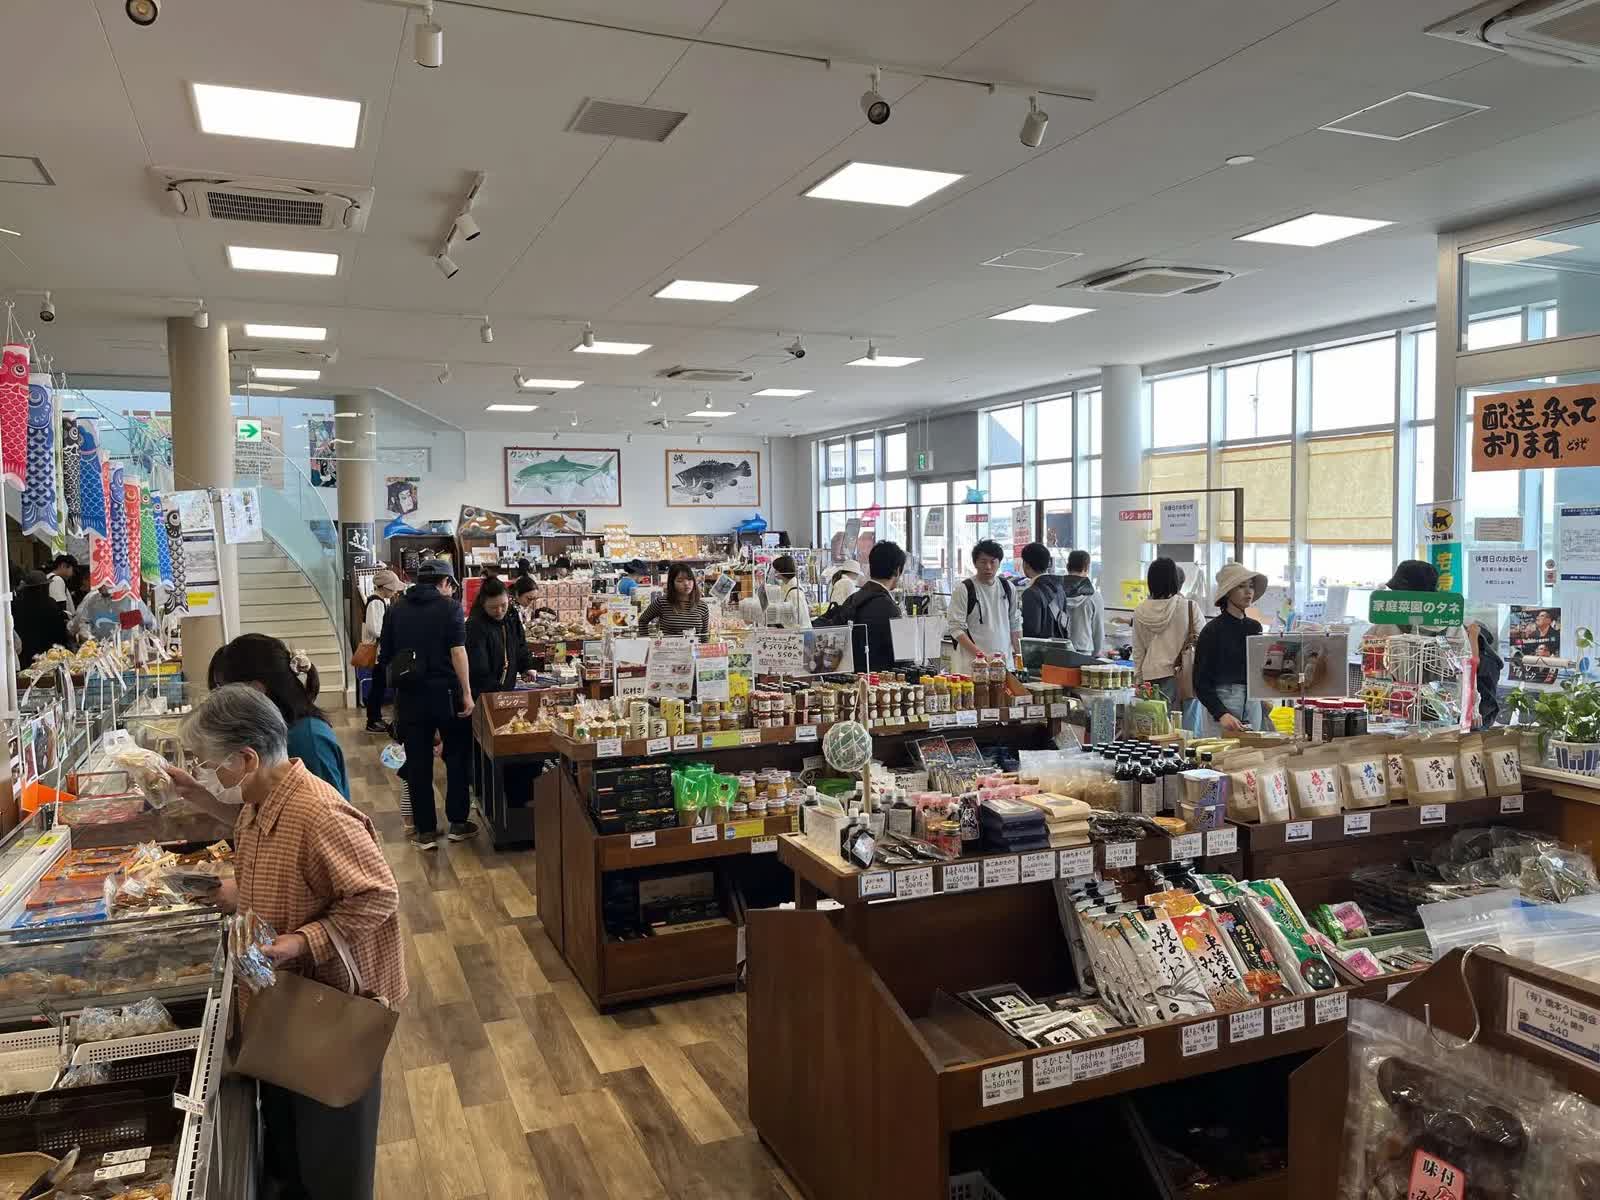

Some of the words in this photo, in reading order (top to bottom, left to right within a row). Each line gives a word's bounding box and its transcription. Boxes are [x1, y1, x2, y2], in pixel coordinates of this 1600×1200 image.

[1482, 396, 1597, 430] 配送承って
[1374, 600, 1460, 614] 家庭菜園のタネ
[1549, 1023, 1568, 1038] 540
[1423, 1158, 1456, 1187] 味付
